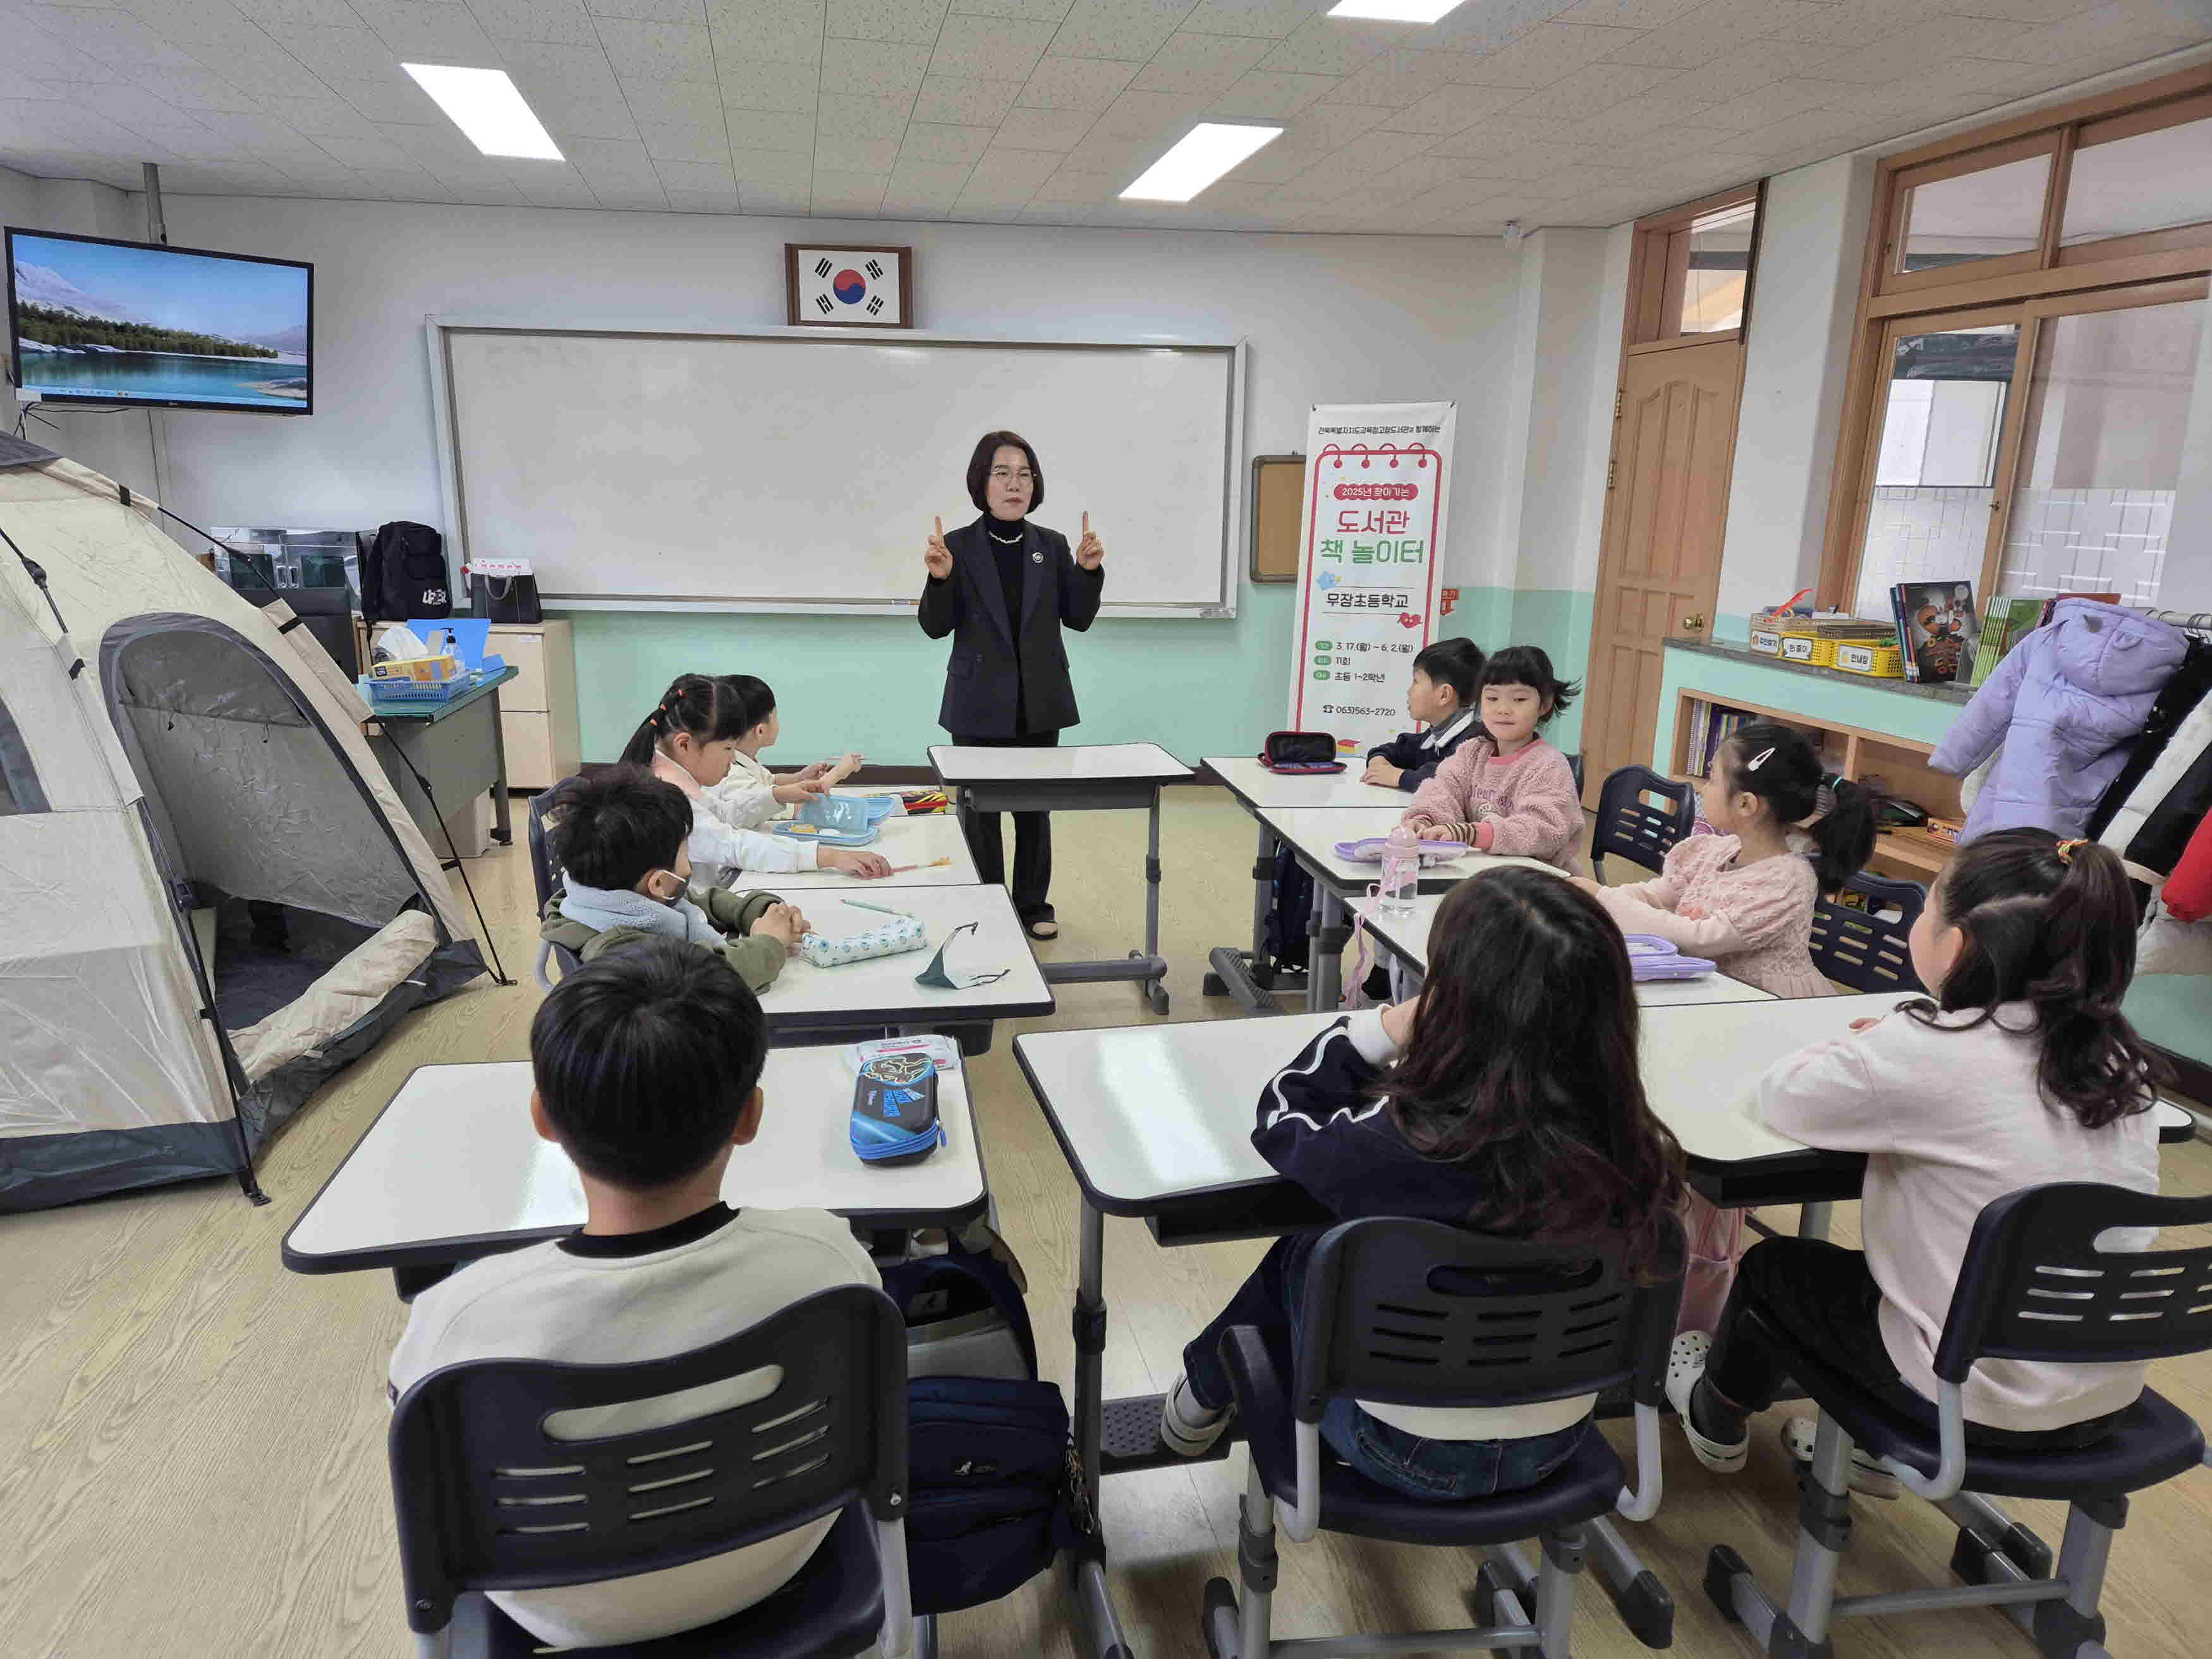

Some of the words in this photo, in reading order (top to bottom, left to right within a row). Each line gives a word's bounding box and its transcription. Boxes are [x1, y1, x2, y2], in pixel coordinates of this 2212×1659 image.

[1342, 487, 1371, 497] 2025년
[1374, 487, 1410, 497] 찾아가는
[1337, 510, 1410, 535] 도서관
[1320, 539, 1344, 563] 책
[1352, 540, 1423, 564] 놀이터
[1327, 593, 1409, 608] 무장초등학교
[1335, 672, 1351, 681] 초등
[1336, 705, 1395, 716] 063)563-2720
